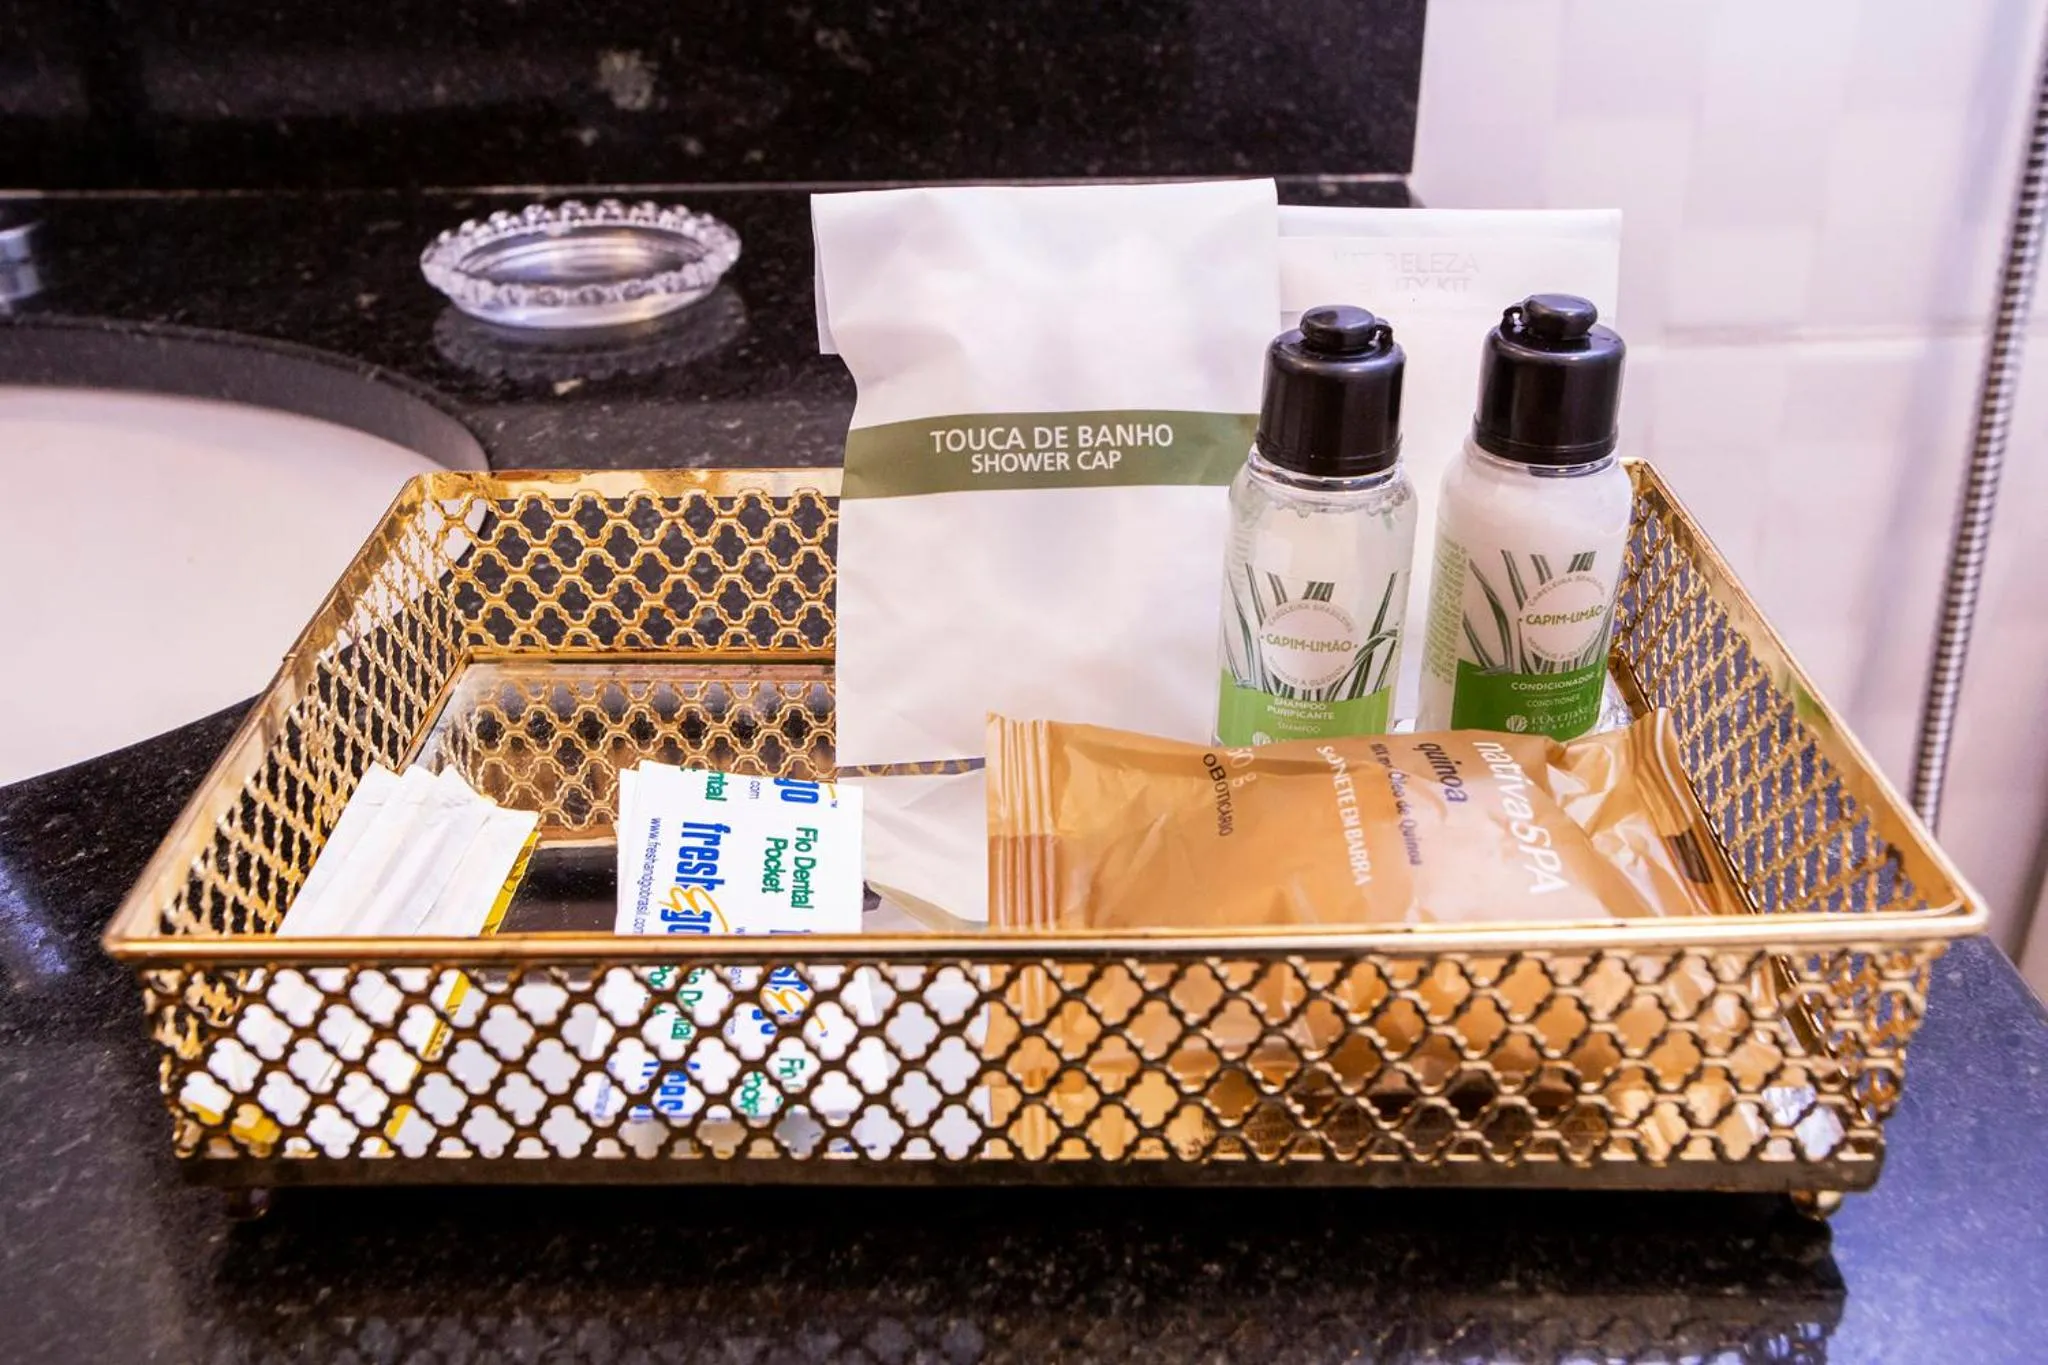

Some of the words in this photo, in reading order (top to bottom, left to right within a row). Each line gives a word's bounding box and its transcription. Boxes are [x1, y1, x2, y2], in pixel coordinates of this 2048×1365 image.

[930, 427, 1026, 453] TOUCA
[1034, 426, 1068, 449] DE
[1078, 424, 1174, 448] BANHO
[971, 452, 1070, 474] SHOWER
[1077, 451, 1122, 470] CAP
[1266, 633, 1352, 653] CAPIM-LIMÃO
[1412, 743, 1468, 802] quinoa
[1339, 807, 1361, 828] EM
[794, 827, 819, 852] Fio
[1344, 827, 1373, 887] BARRA
[1399, 818, 1423, 866] Quinoa
[761, 837, 789, 894] Pocket
[790, 856, 818, 910] Dental
